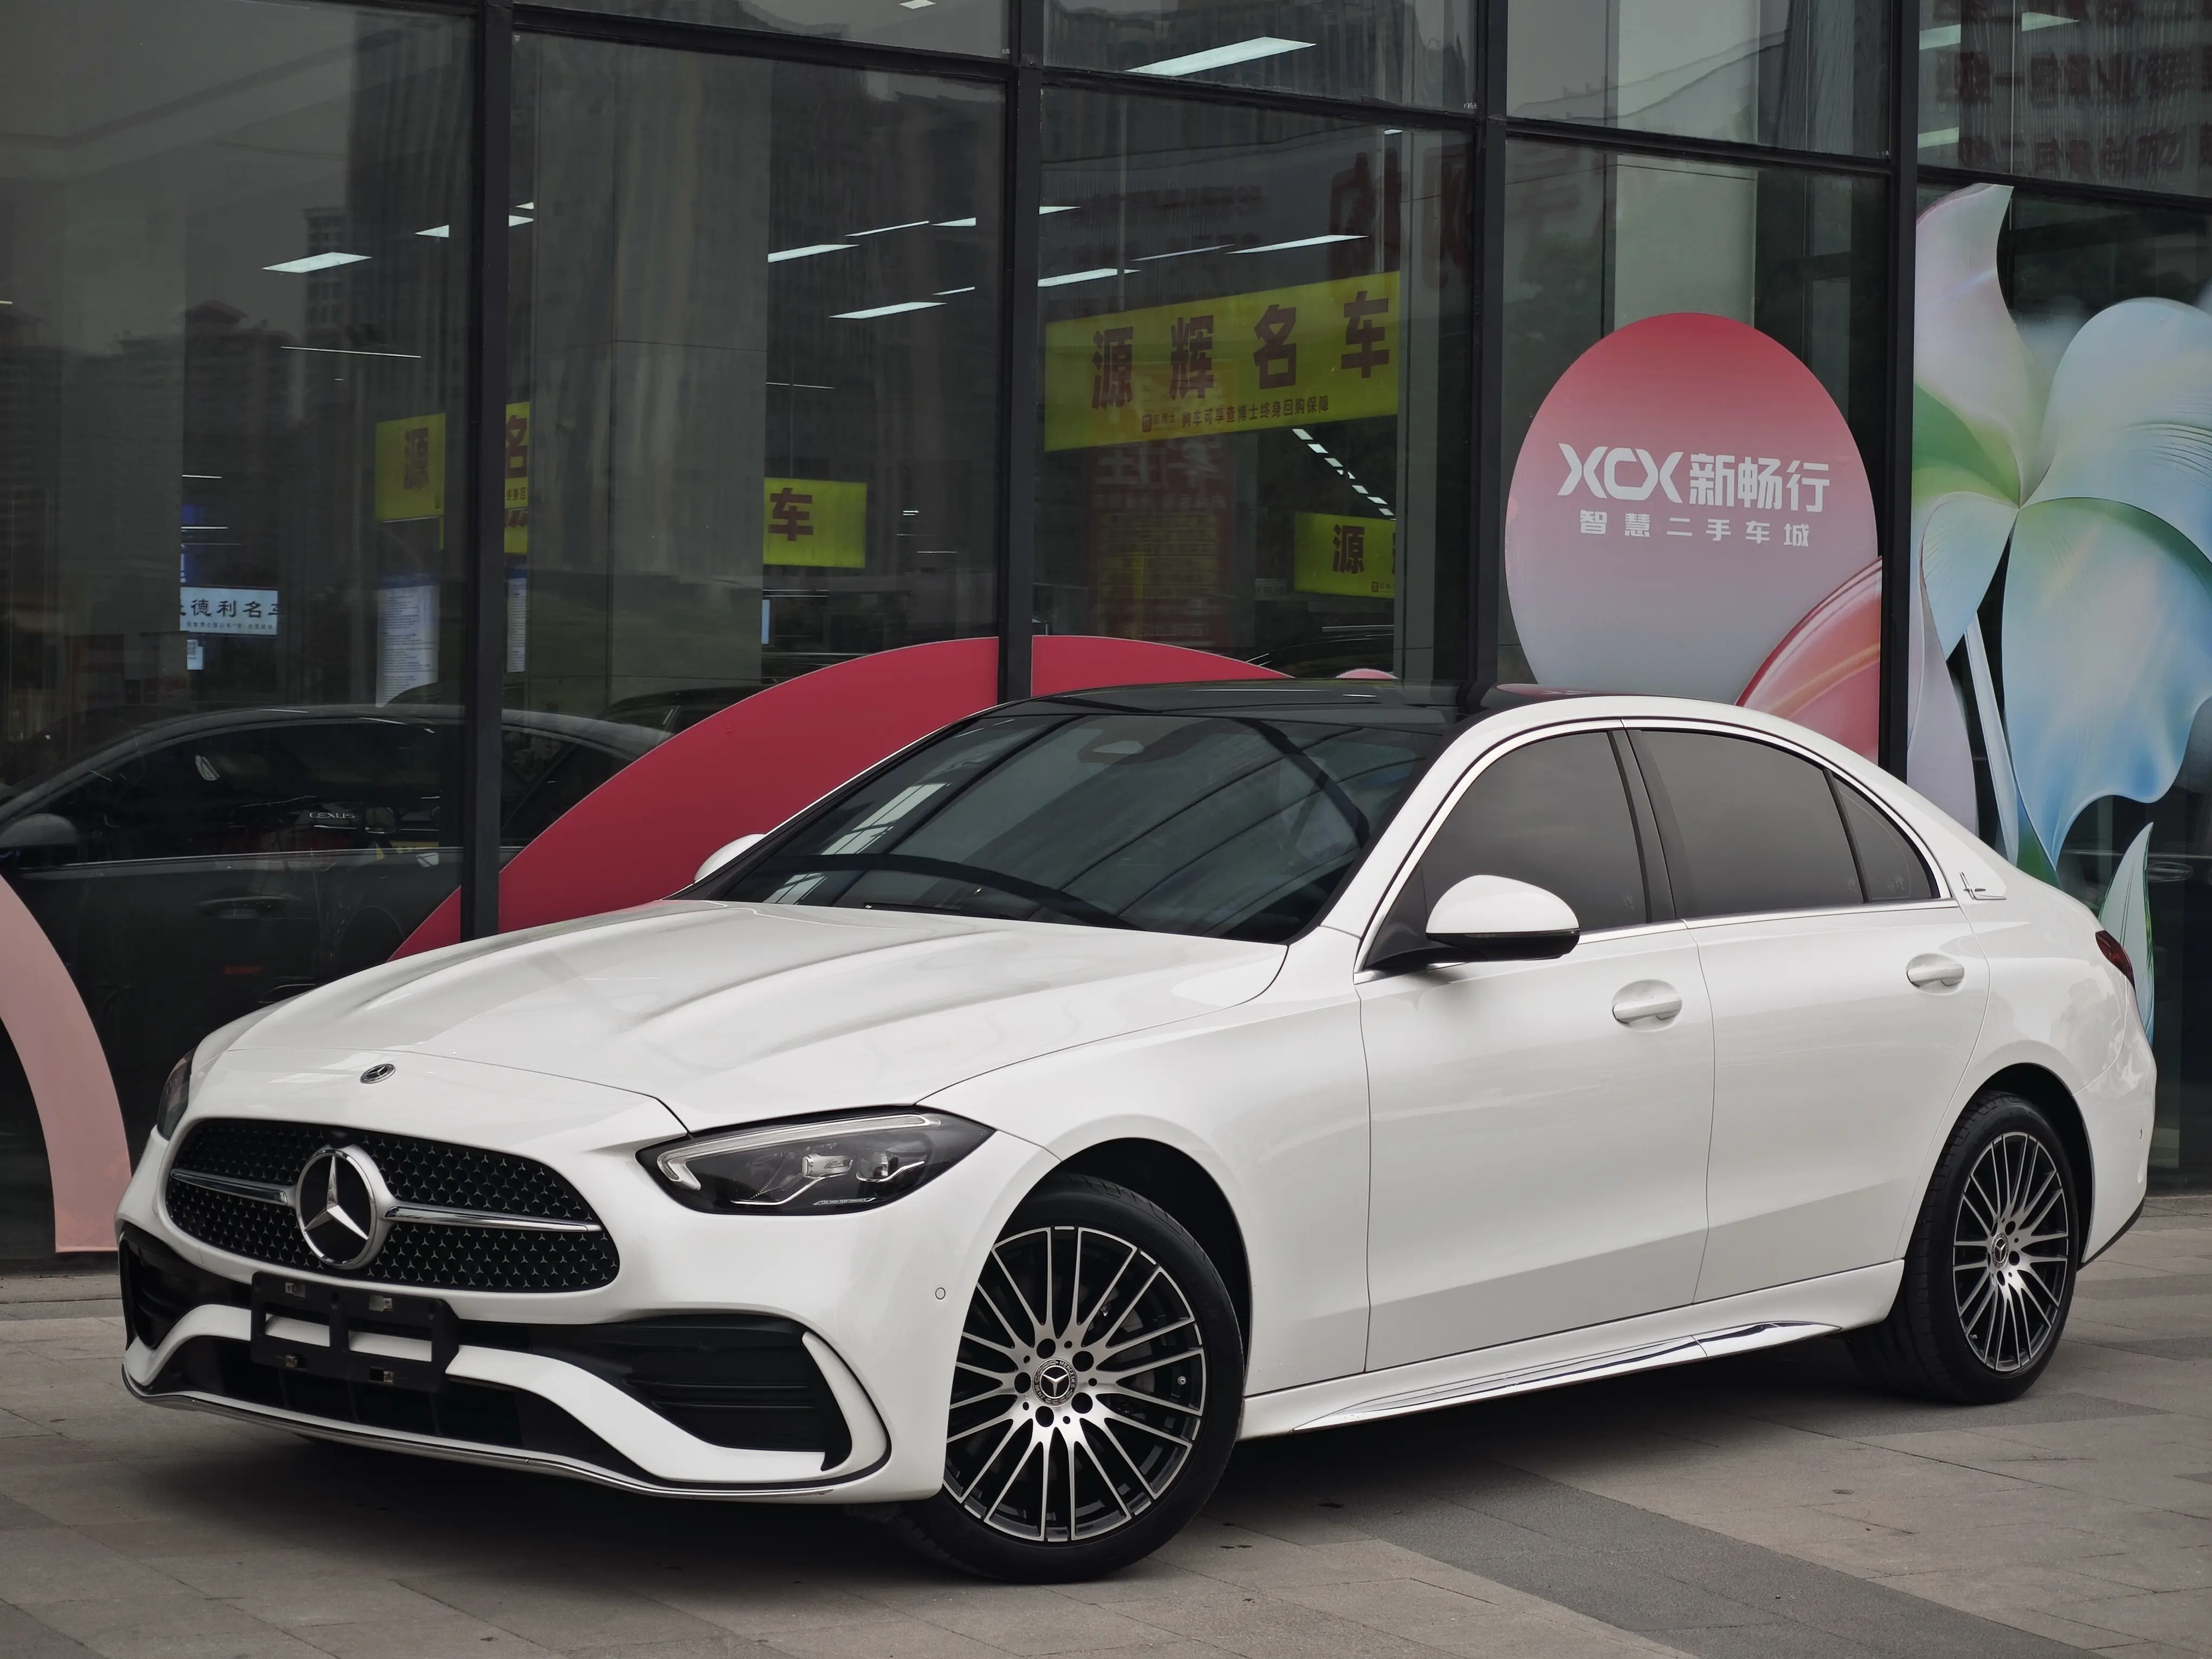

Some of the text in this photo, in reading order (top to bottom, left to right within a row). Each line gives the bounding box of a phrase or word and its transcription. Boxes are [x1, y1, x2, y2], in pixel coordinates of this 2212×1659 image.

[1091, 291, 1390, 410] 源辉名车
[1182, 395, 1329, 428] 购车可享查博士终身回购保障
[1689, 453, 1830, 513] 新畅行
[767, 487, 814, 542] 车
[1579, 510, 1809, 546] 智慧二手车城
